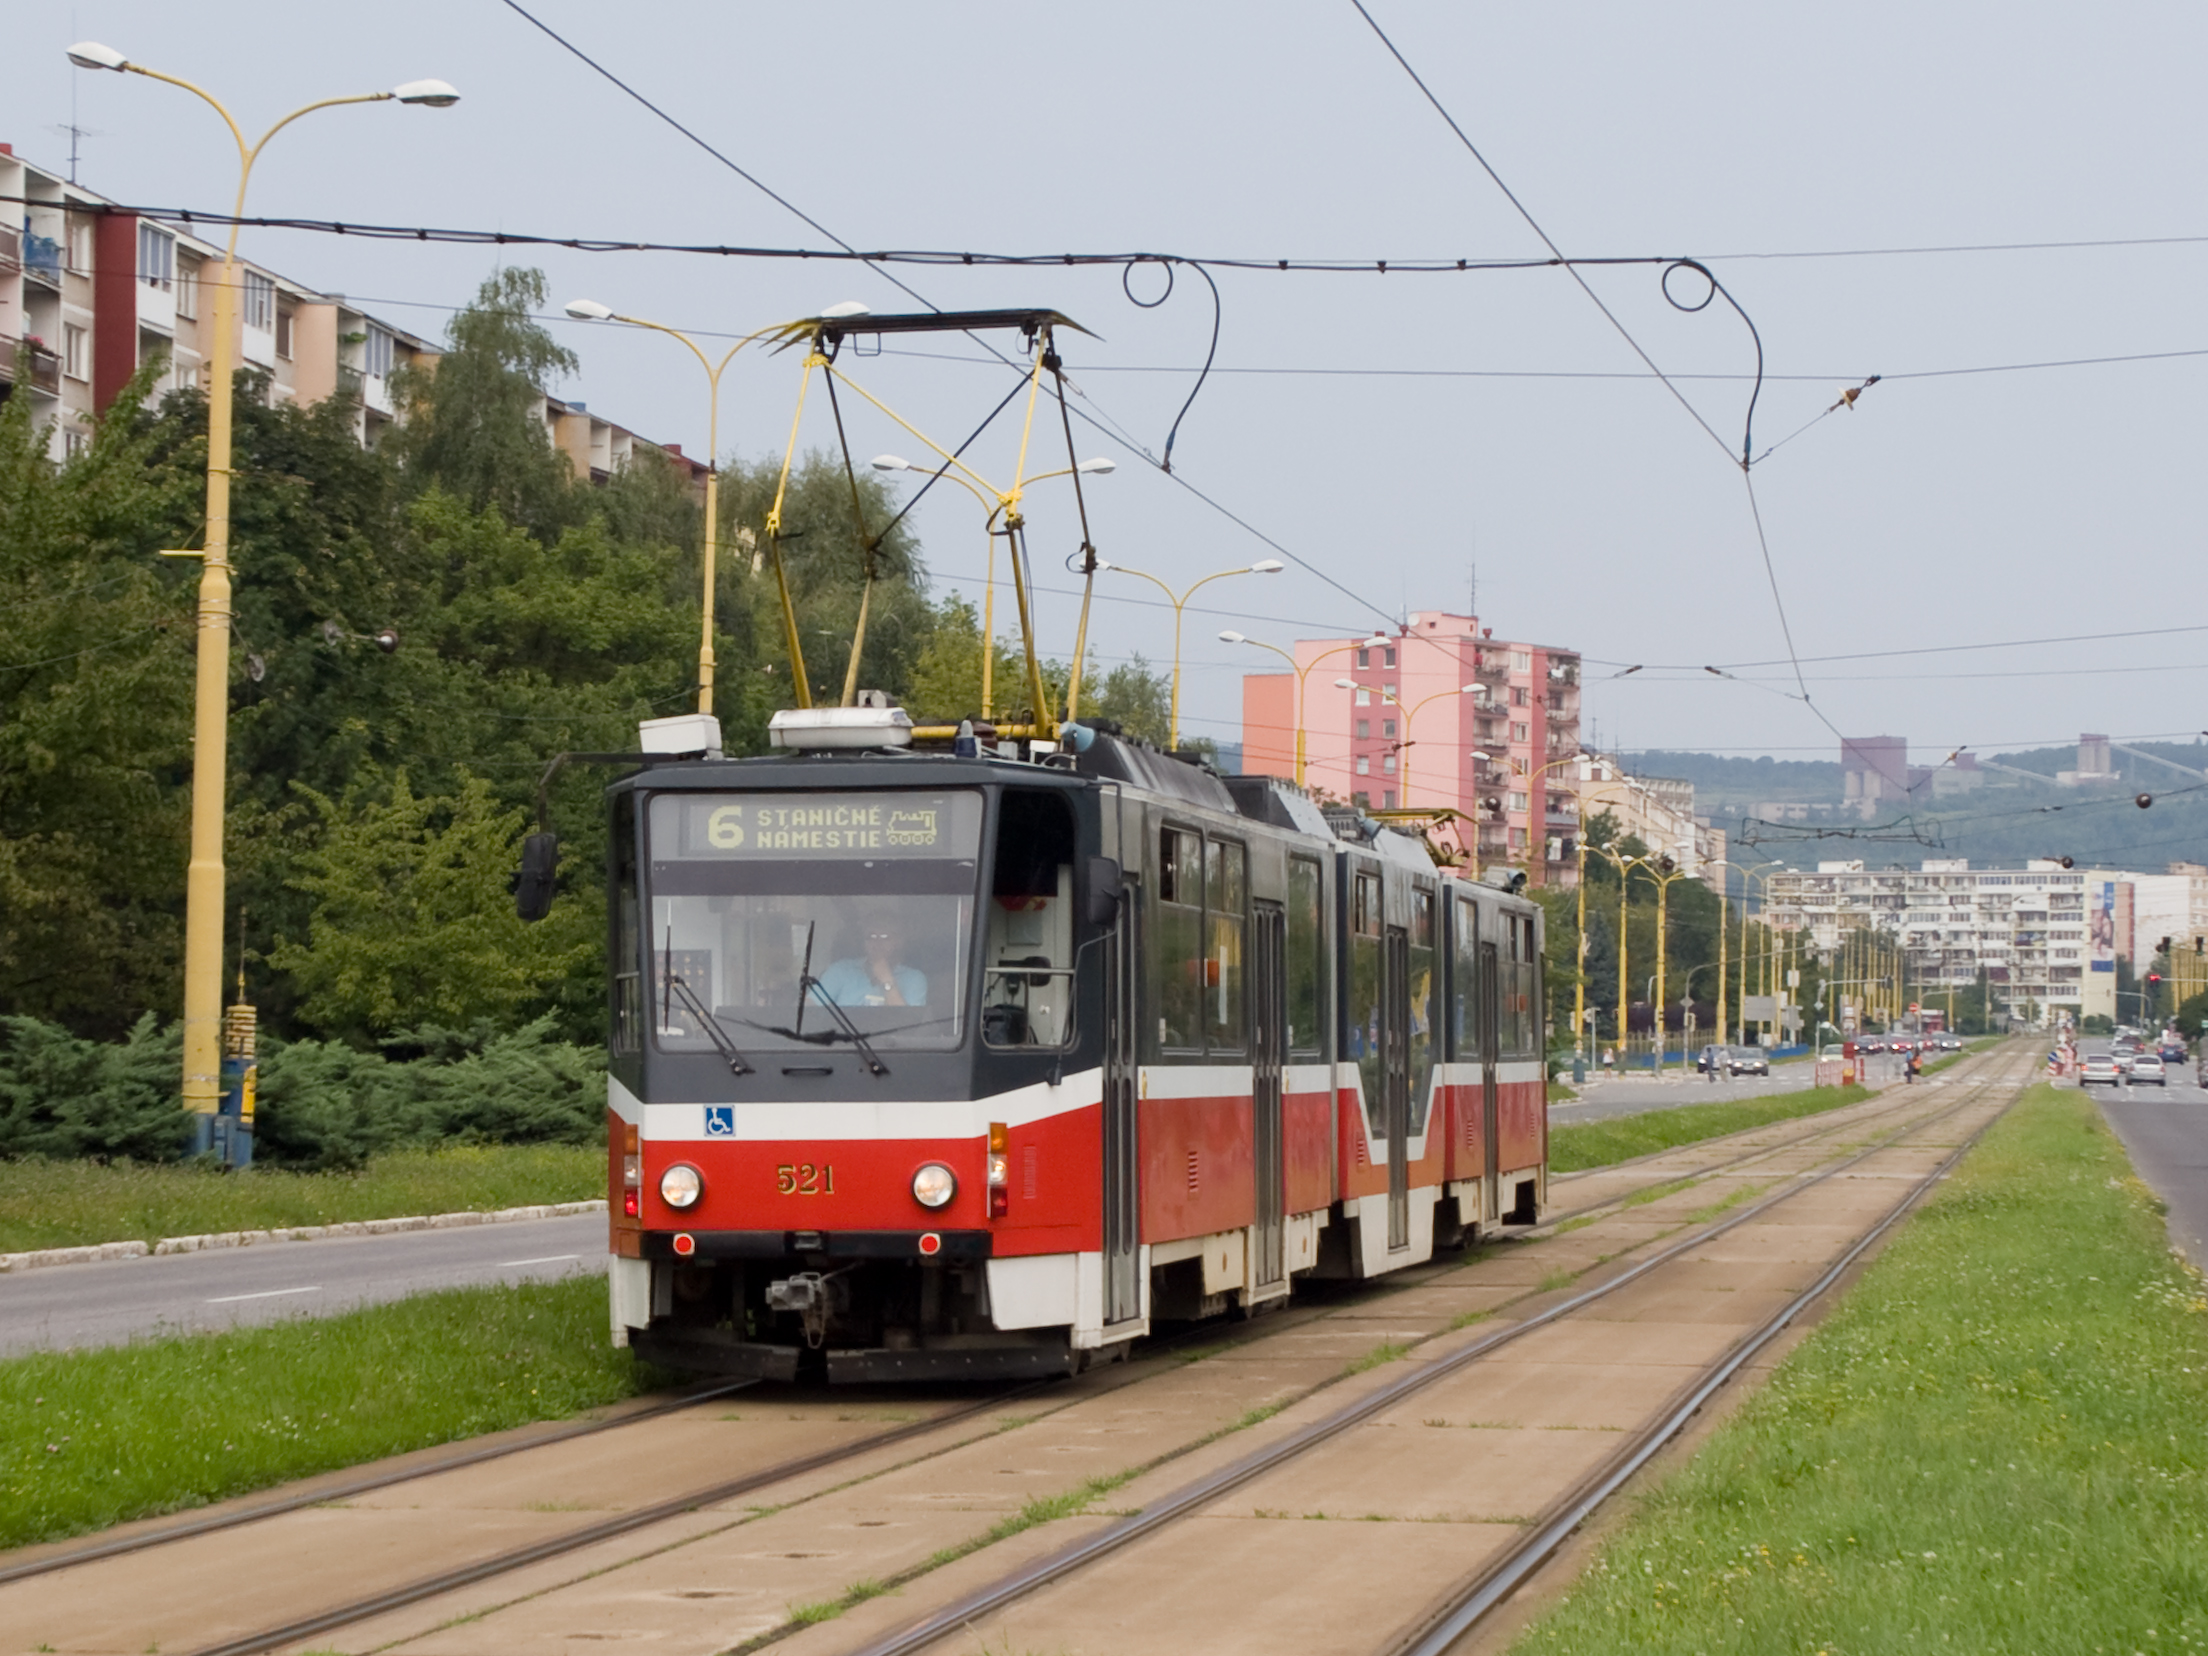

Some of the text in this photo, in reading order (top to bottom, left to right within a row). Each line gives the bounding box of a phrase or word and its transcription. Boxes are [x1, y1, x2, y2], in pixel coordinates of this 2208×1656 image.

[707, 805, 745, 849] 6
[757, 805, 882, 826] STANIČNÉ
[757, 824, 882, 848] NÁMESTIE
[777, 1164, 835, 1195] 521
